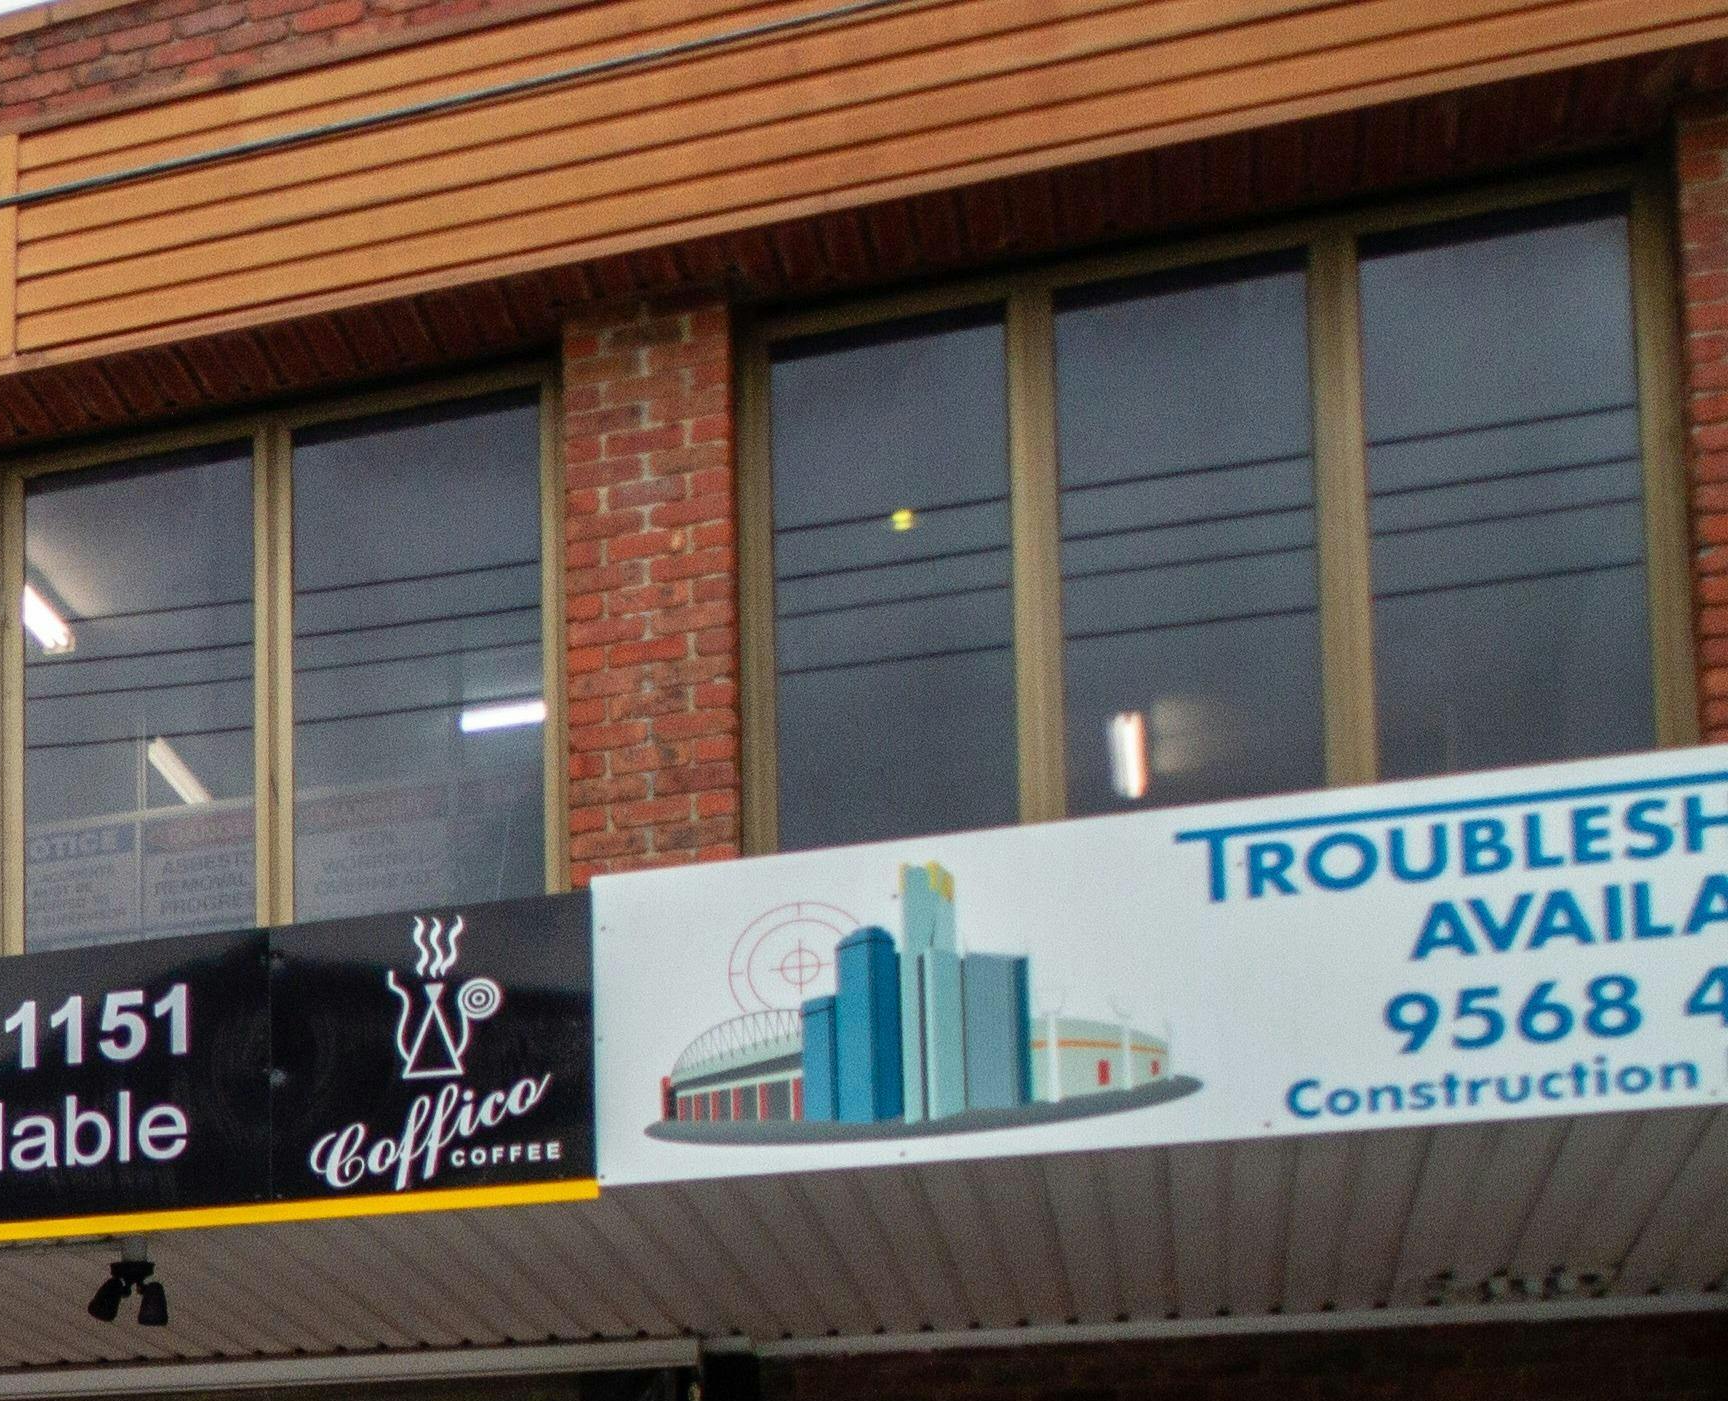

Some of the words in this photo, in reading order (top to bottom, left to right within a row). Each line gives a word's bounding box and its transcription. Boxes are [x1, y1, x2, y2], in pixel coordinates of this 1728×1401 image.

[1409, 873, 1728, 961] AVAILA
[4, 982, 191, 1070] 1151
[1383, 973, 1642, 1055] 9568
[1286, 1055, 1700, 1120] Construction
[310, 1072, 551, 1191] Coffico
[450, 1140, 562, 1168] COFFEE
